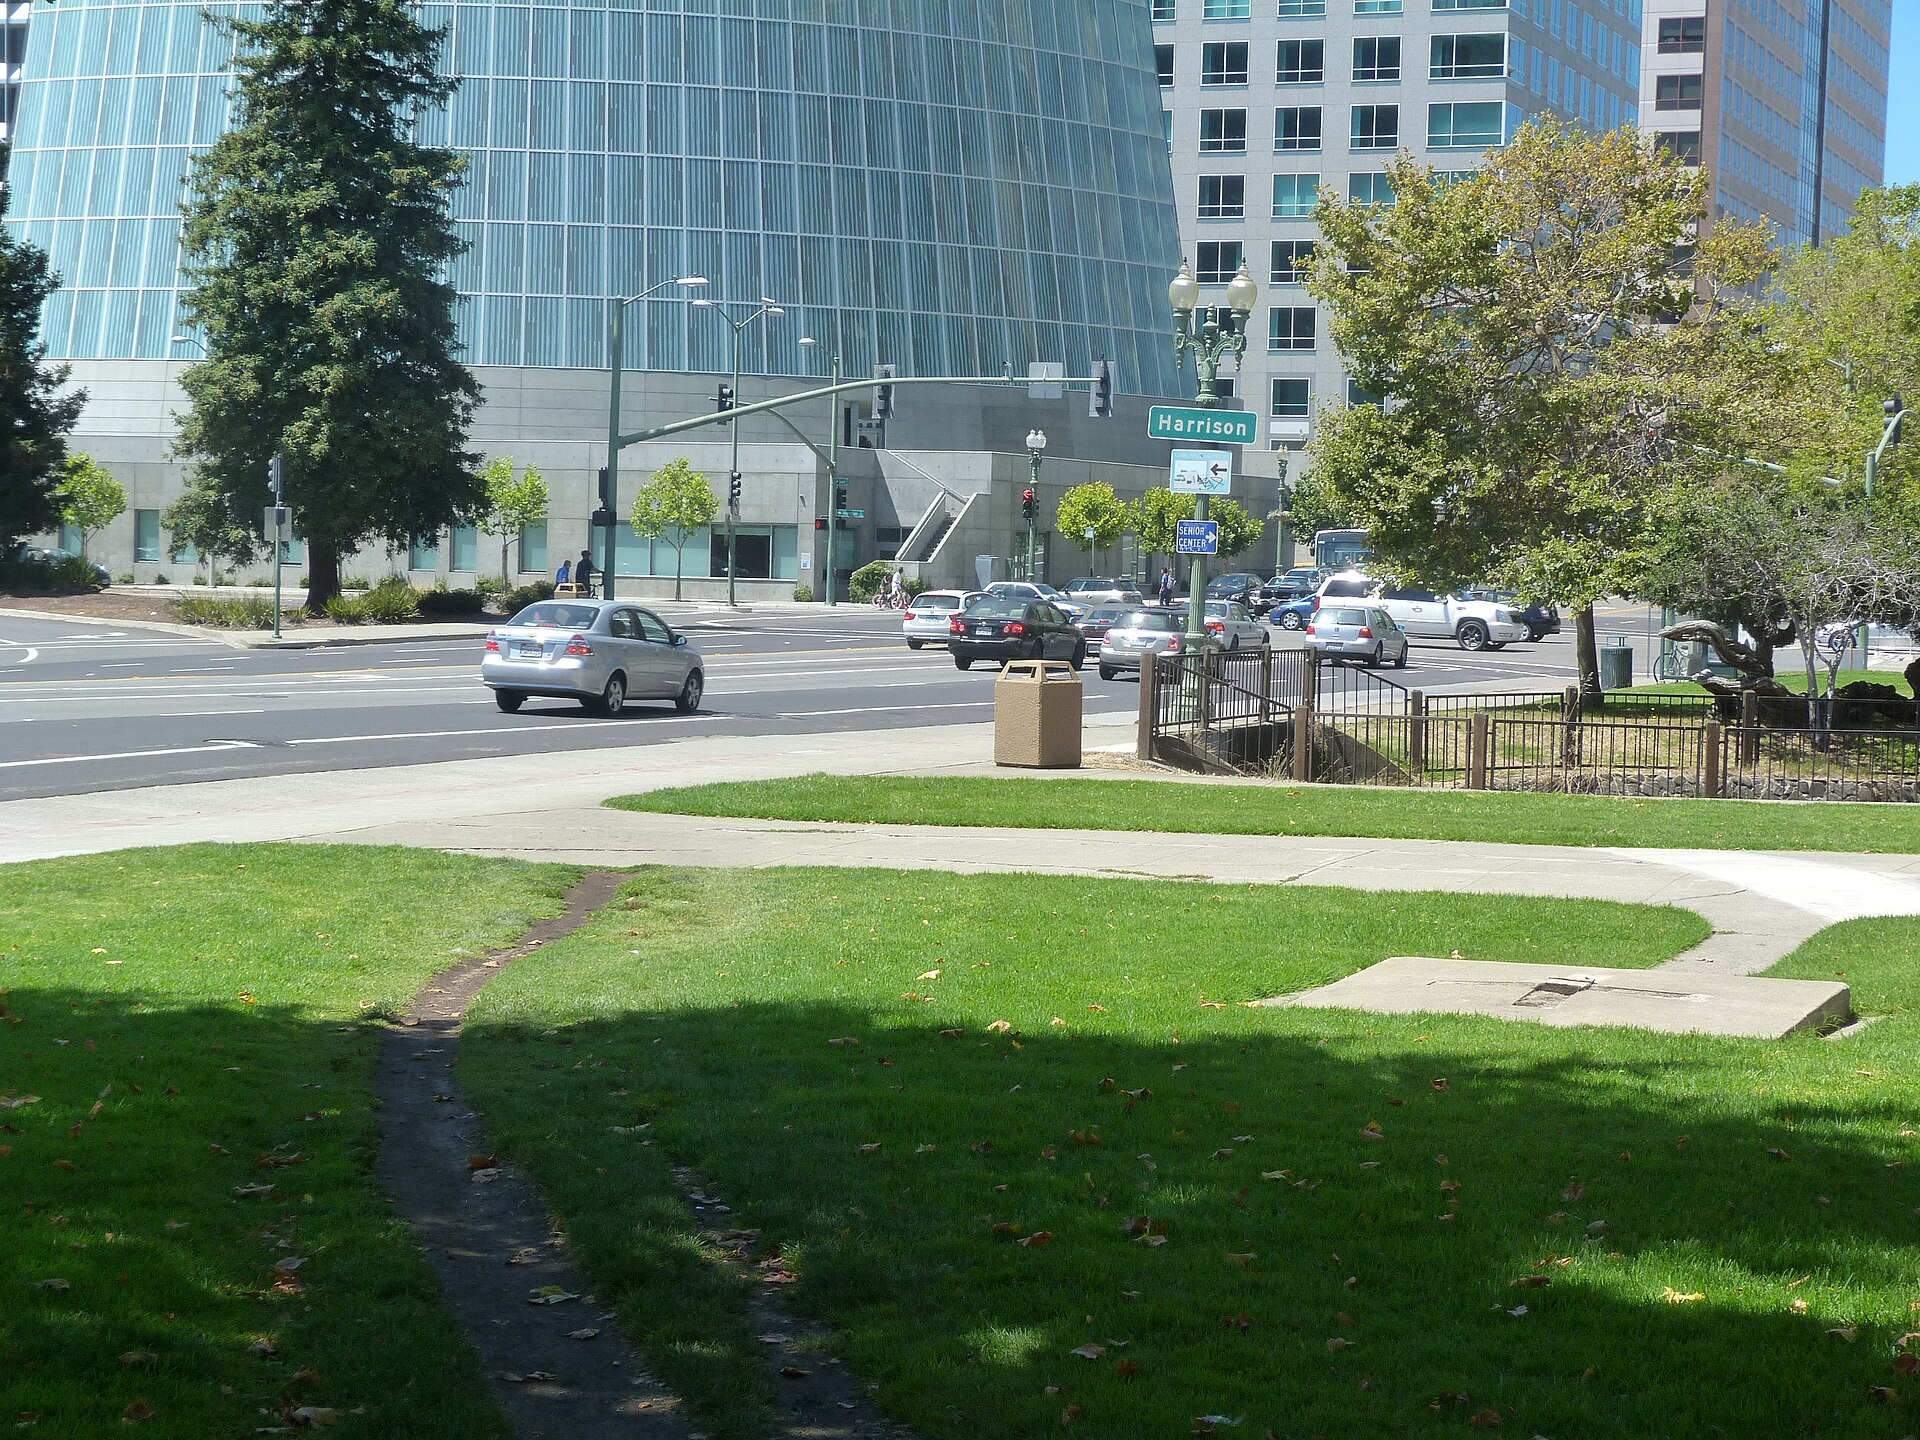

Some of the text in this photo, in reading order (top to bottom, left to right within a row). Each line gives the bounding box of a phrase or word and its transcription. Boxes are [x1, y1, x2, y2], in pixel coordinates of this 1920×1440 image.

[1158, 414, 1247, 436] Harrison
[1179, 526, 1205, 536] SENIOR
[1178, 537, 1207, 548] CENTER
